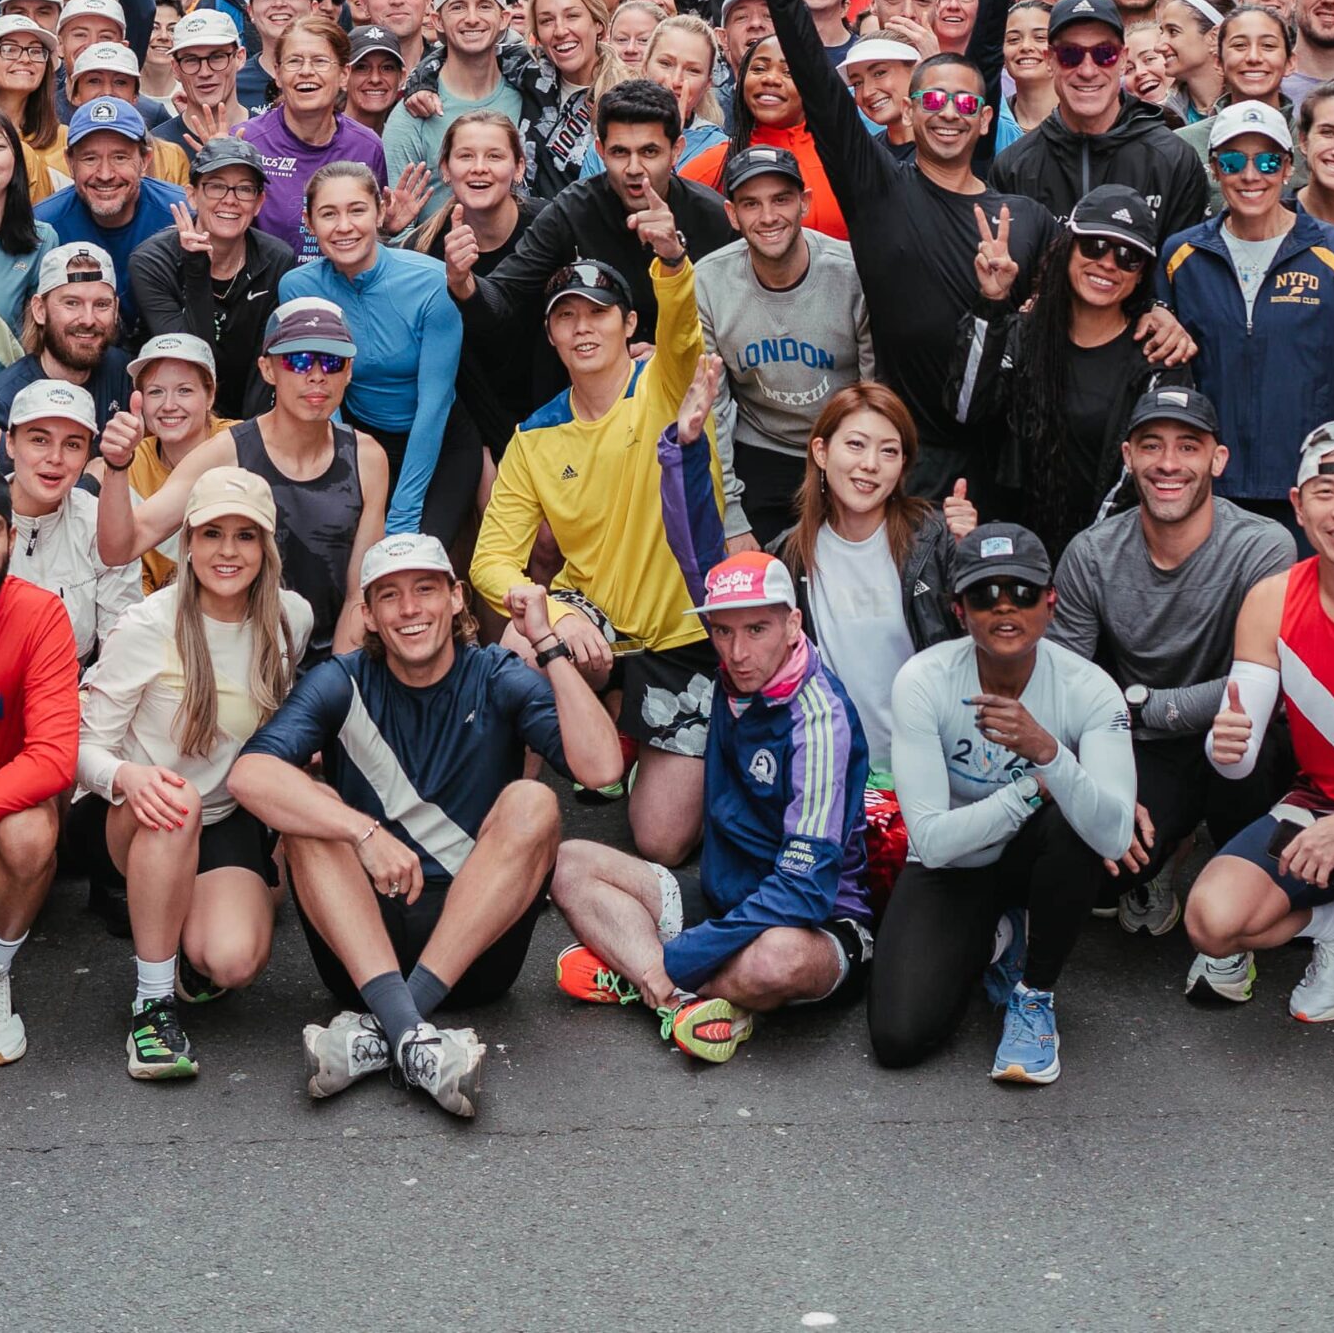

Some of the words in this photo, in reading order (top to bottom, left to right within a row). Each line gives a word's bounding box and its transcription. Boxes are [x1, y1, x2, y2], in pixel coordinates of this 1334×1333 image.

[1274, 271, 1320, 291] NYPD
[736, 337, 835, 373] LONDON
[46, 388, 75, 401] LONDON
